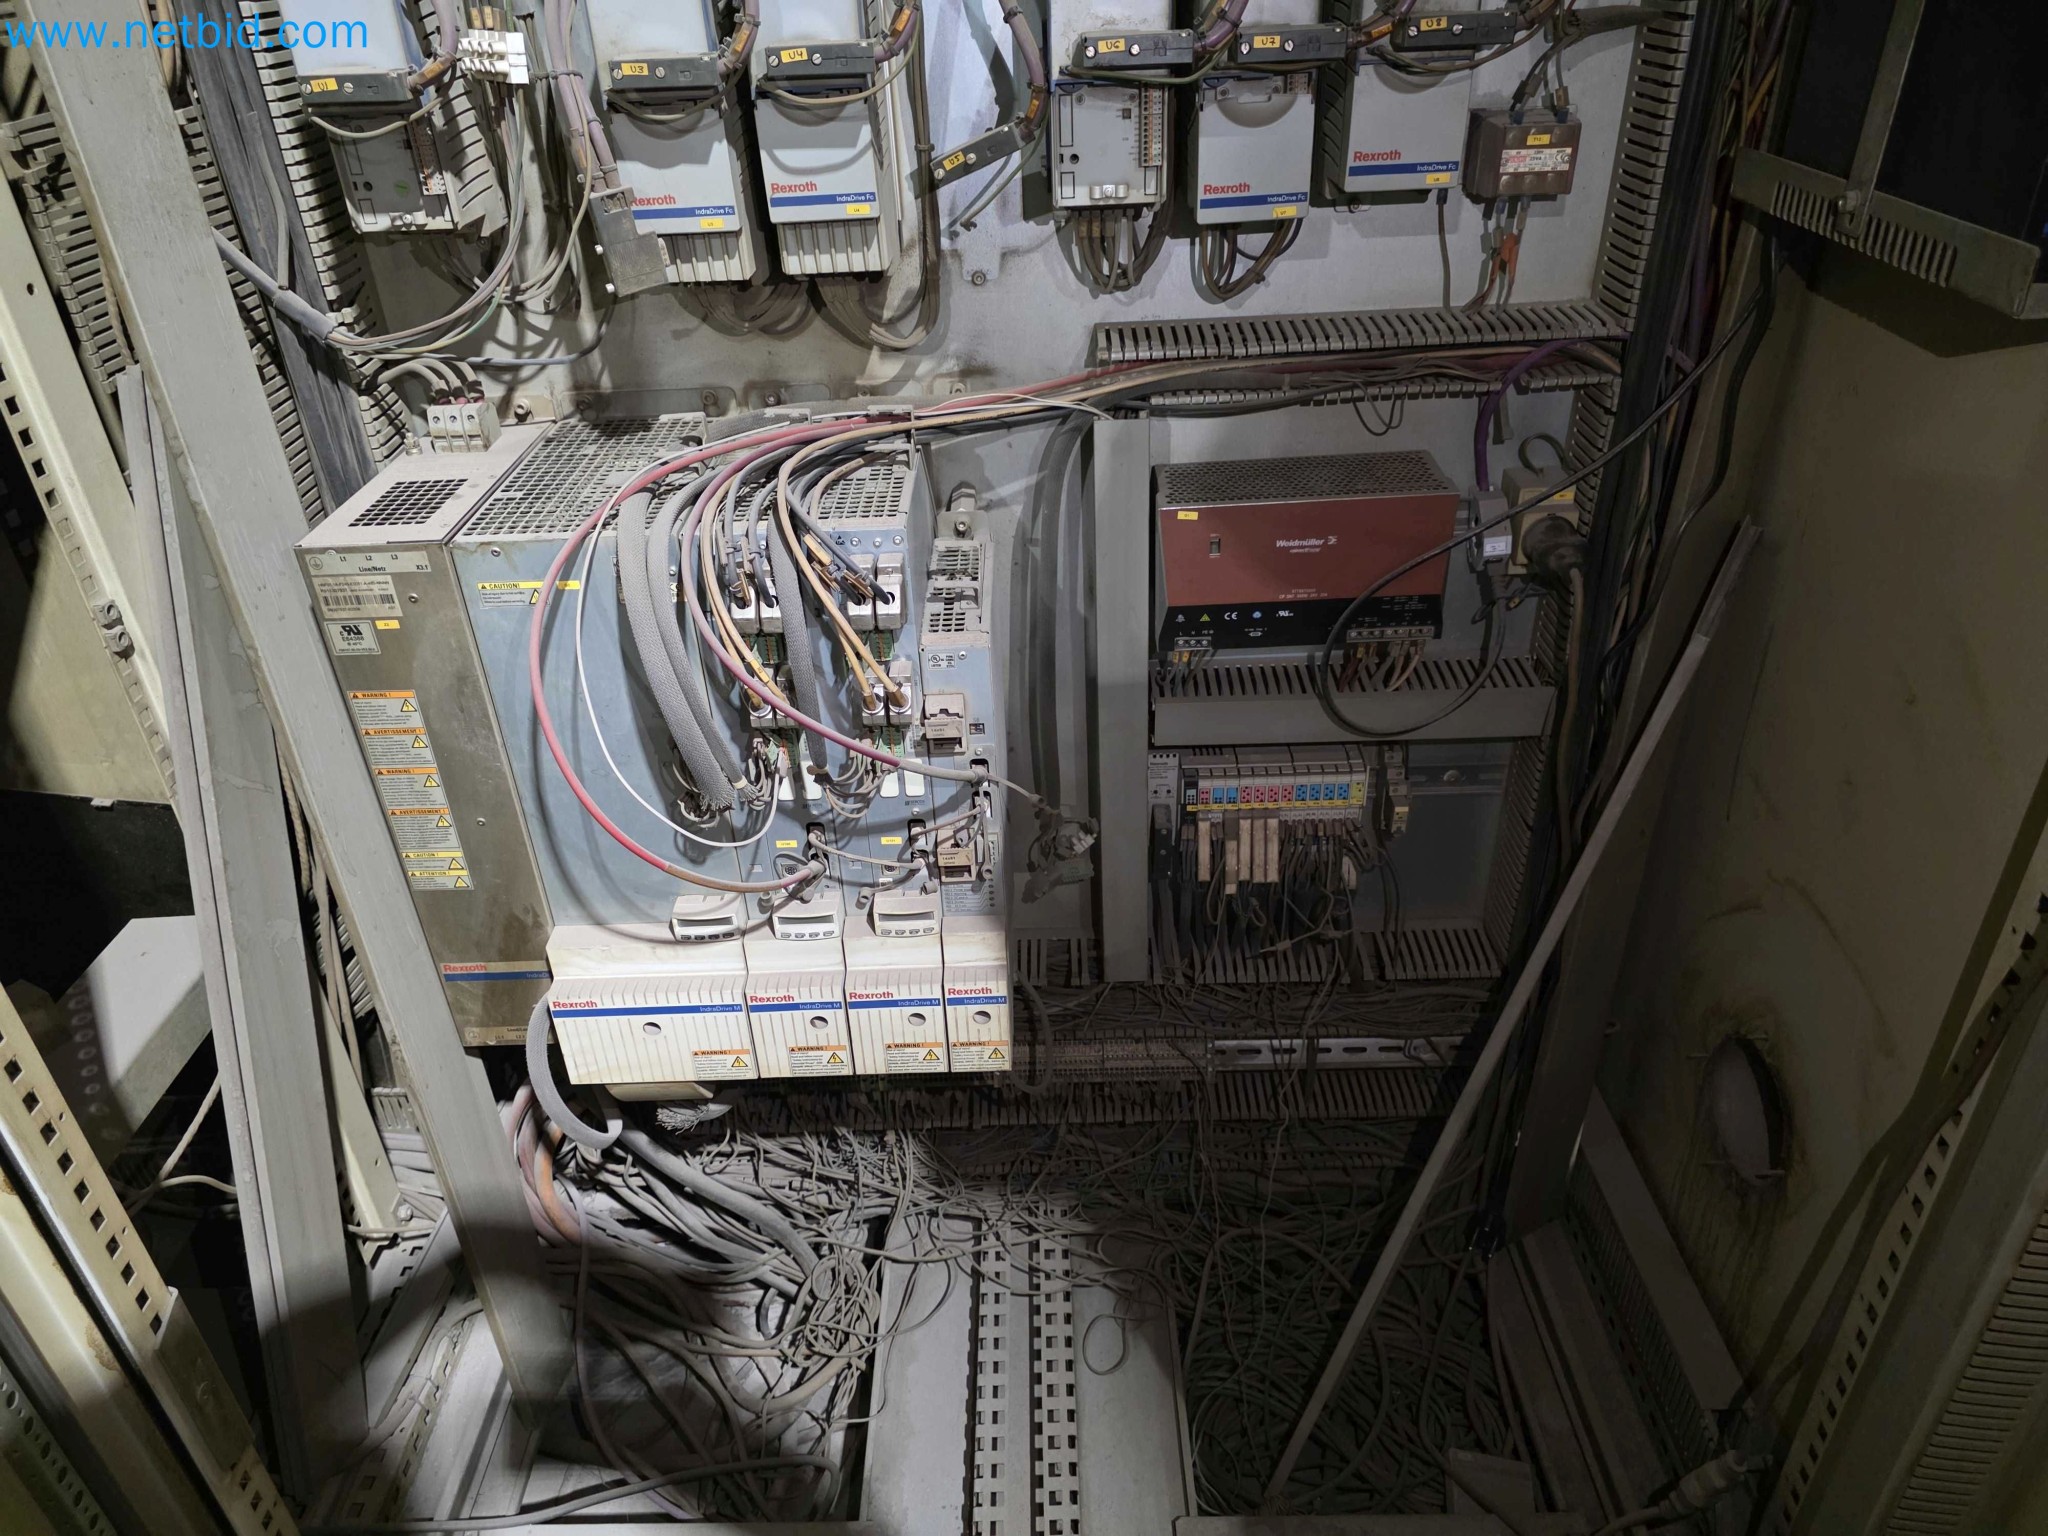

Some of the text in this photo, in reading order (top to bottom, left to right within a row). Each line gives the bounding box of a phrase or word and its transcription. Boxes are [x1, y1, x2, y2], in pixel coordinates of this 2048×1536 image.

[1105, 40, 1121, 50] U6
[1261, 36, 1277, 46] U7
[788, 51, 804, 60] U4
[630, 65, 645, 74] U3
[1353, 149, 1401, 163] Rexroth
[1416, 164, 1446, 172] IndraDrive
[770, 181, 818, 194] Rexroth
[1203, 182, 1251, 195] Rexroth
[630, 194, 676, 207] Rexroth
[836, 194, 866, 202] IndraDrive
[1267, 195, 1297, 203] IndraDrive
[1275, 538, 1325, 548] Weidmüller
[489, 582, 520, 590] CAUTION!
[443, 963, 487, 973] Rexroth
[849, 991, 894, 1000] Rexroth
[948, 987, 993, 996] Rexroth
[750, 994, 795, 1004] Rexroth
[964, 997, 998, 1005] IndraDrive
[552, 999, 598, 1009] Rexroth
[700, 1004, 742, 1013] IndraDrive M
